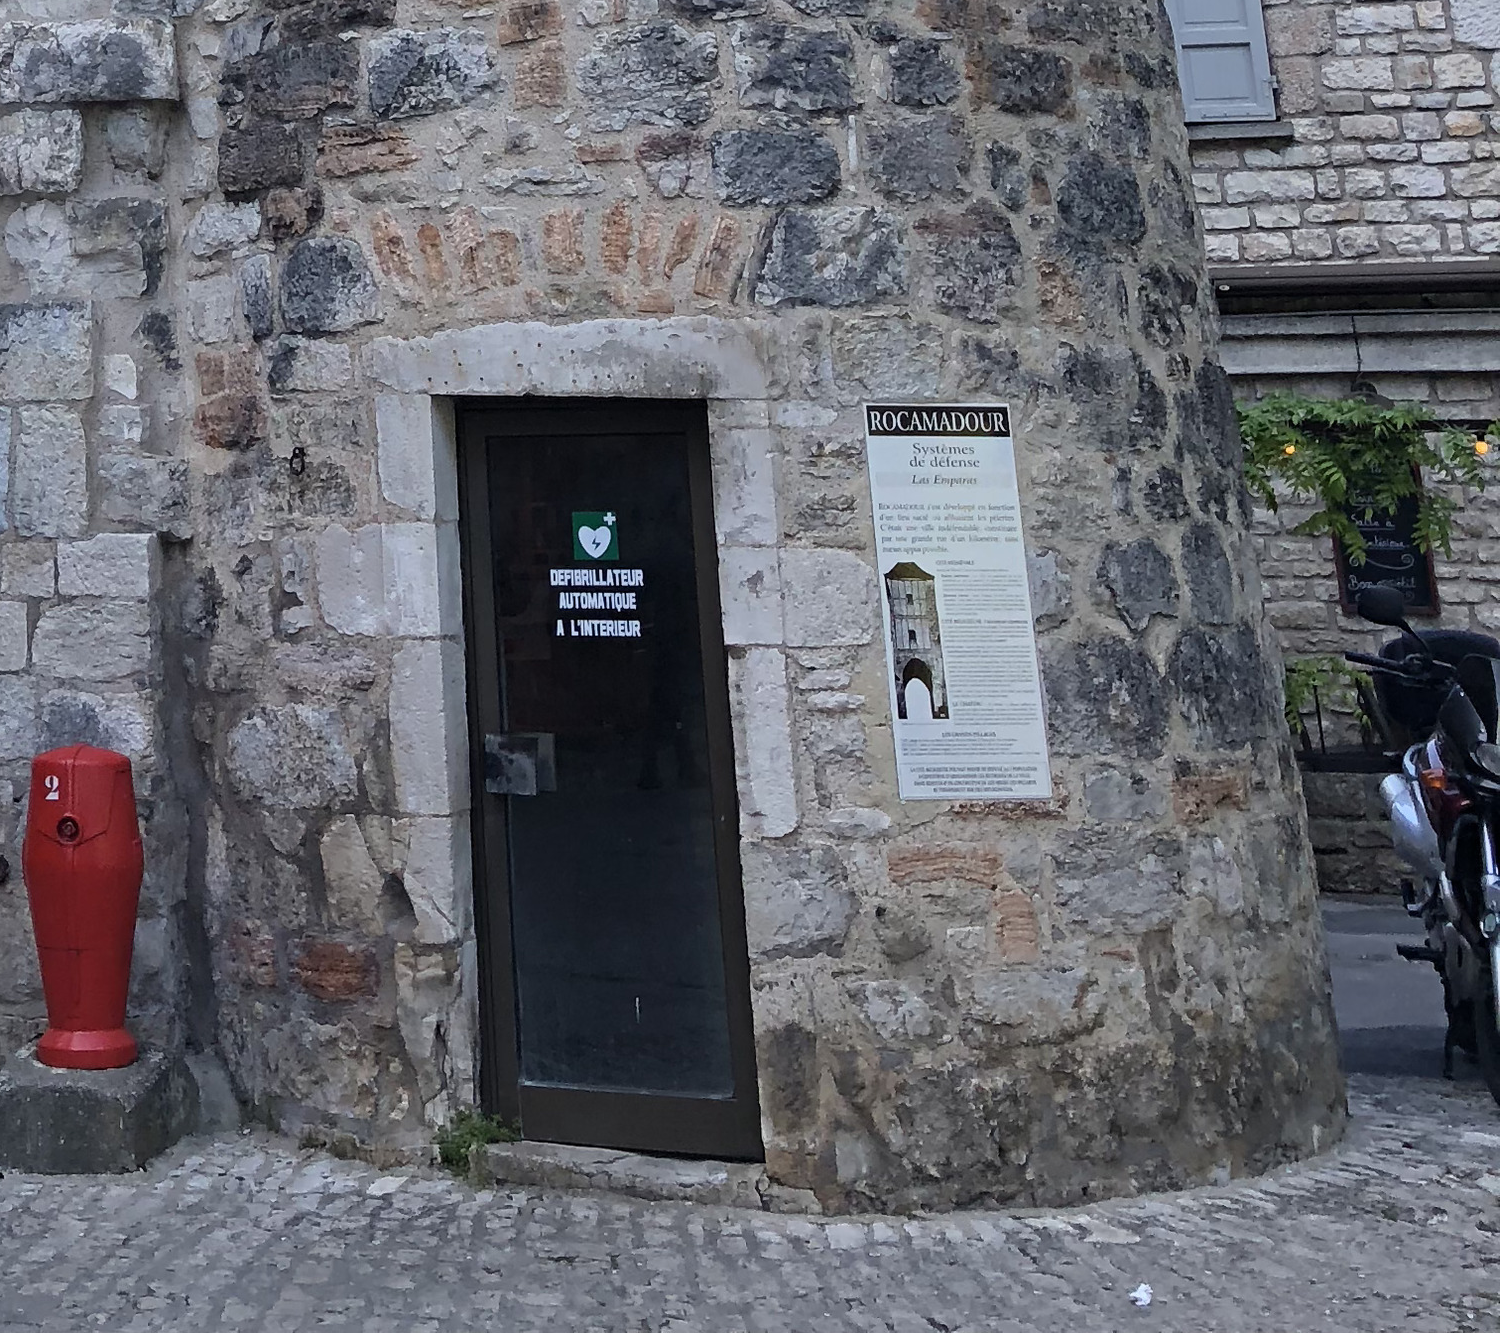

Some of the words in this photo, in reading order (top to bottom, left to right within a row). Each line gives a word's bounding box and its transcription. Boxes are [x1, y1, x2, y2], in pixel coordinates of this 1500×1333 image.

[870, 411, 1007, 432] ROCAMADOUR
[912, 443, 975, 456] Systèmes
[909, 456, 925, 468] de
[930, 457, 980, 468] défense
[550, 569, 644, 586] DEFIBRILLATEUR
[559, 592, 637, 612] AUTOMATIQUE
[556, 620, 565, 636] A
[570, 619, 641, 637] L'INTERIEUR
[44, 775, 60, 800] 2
